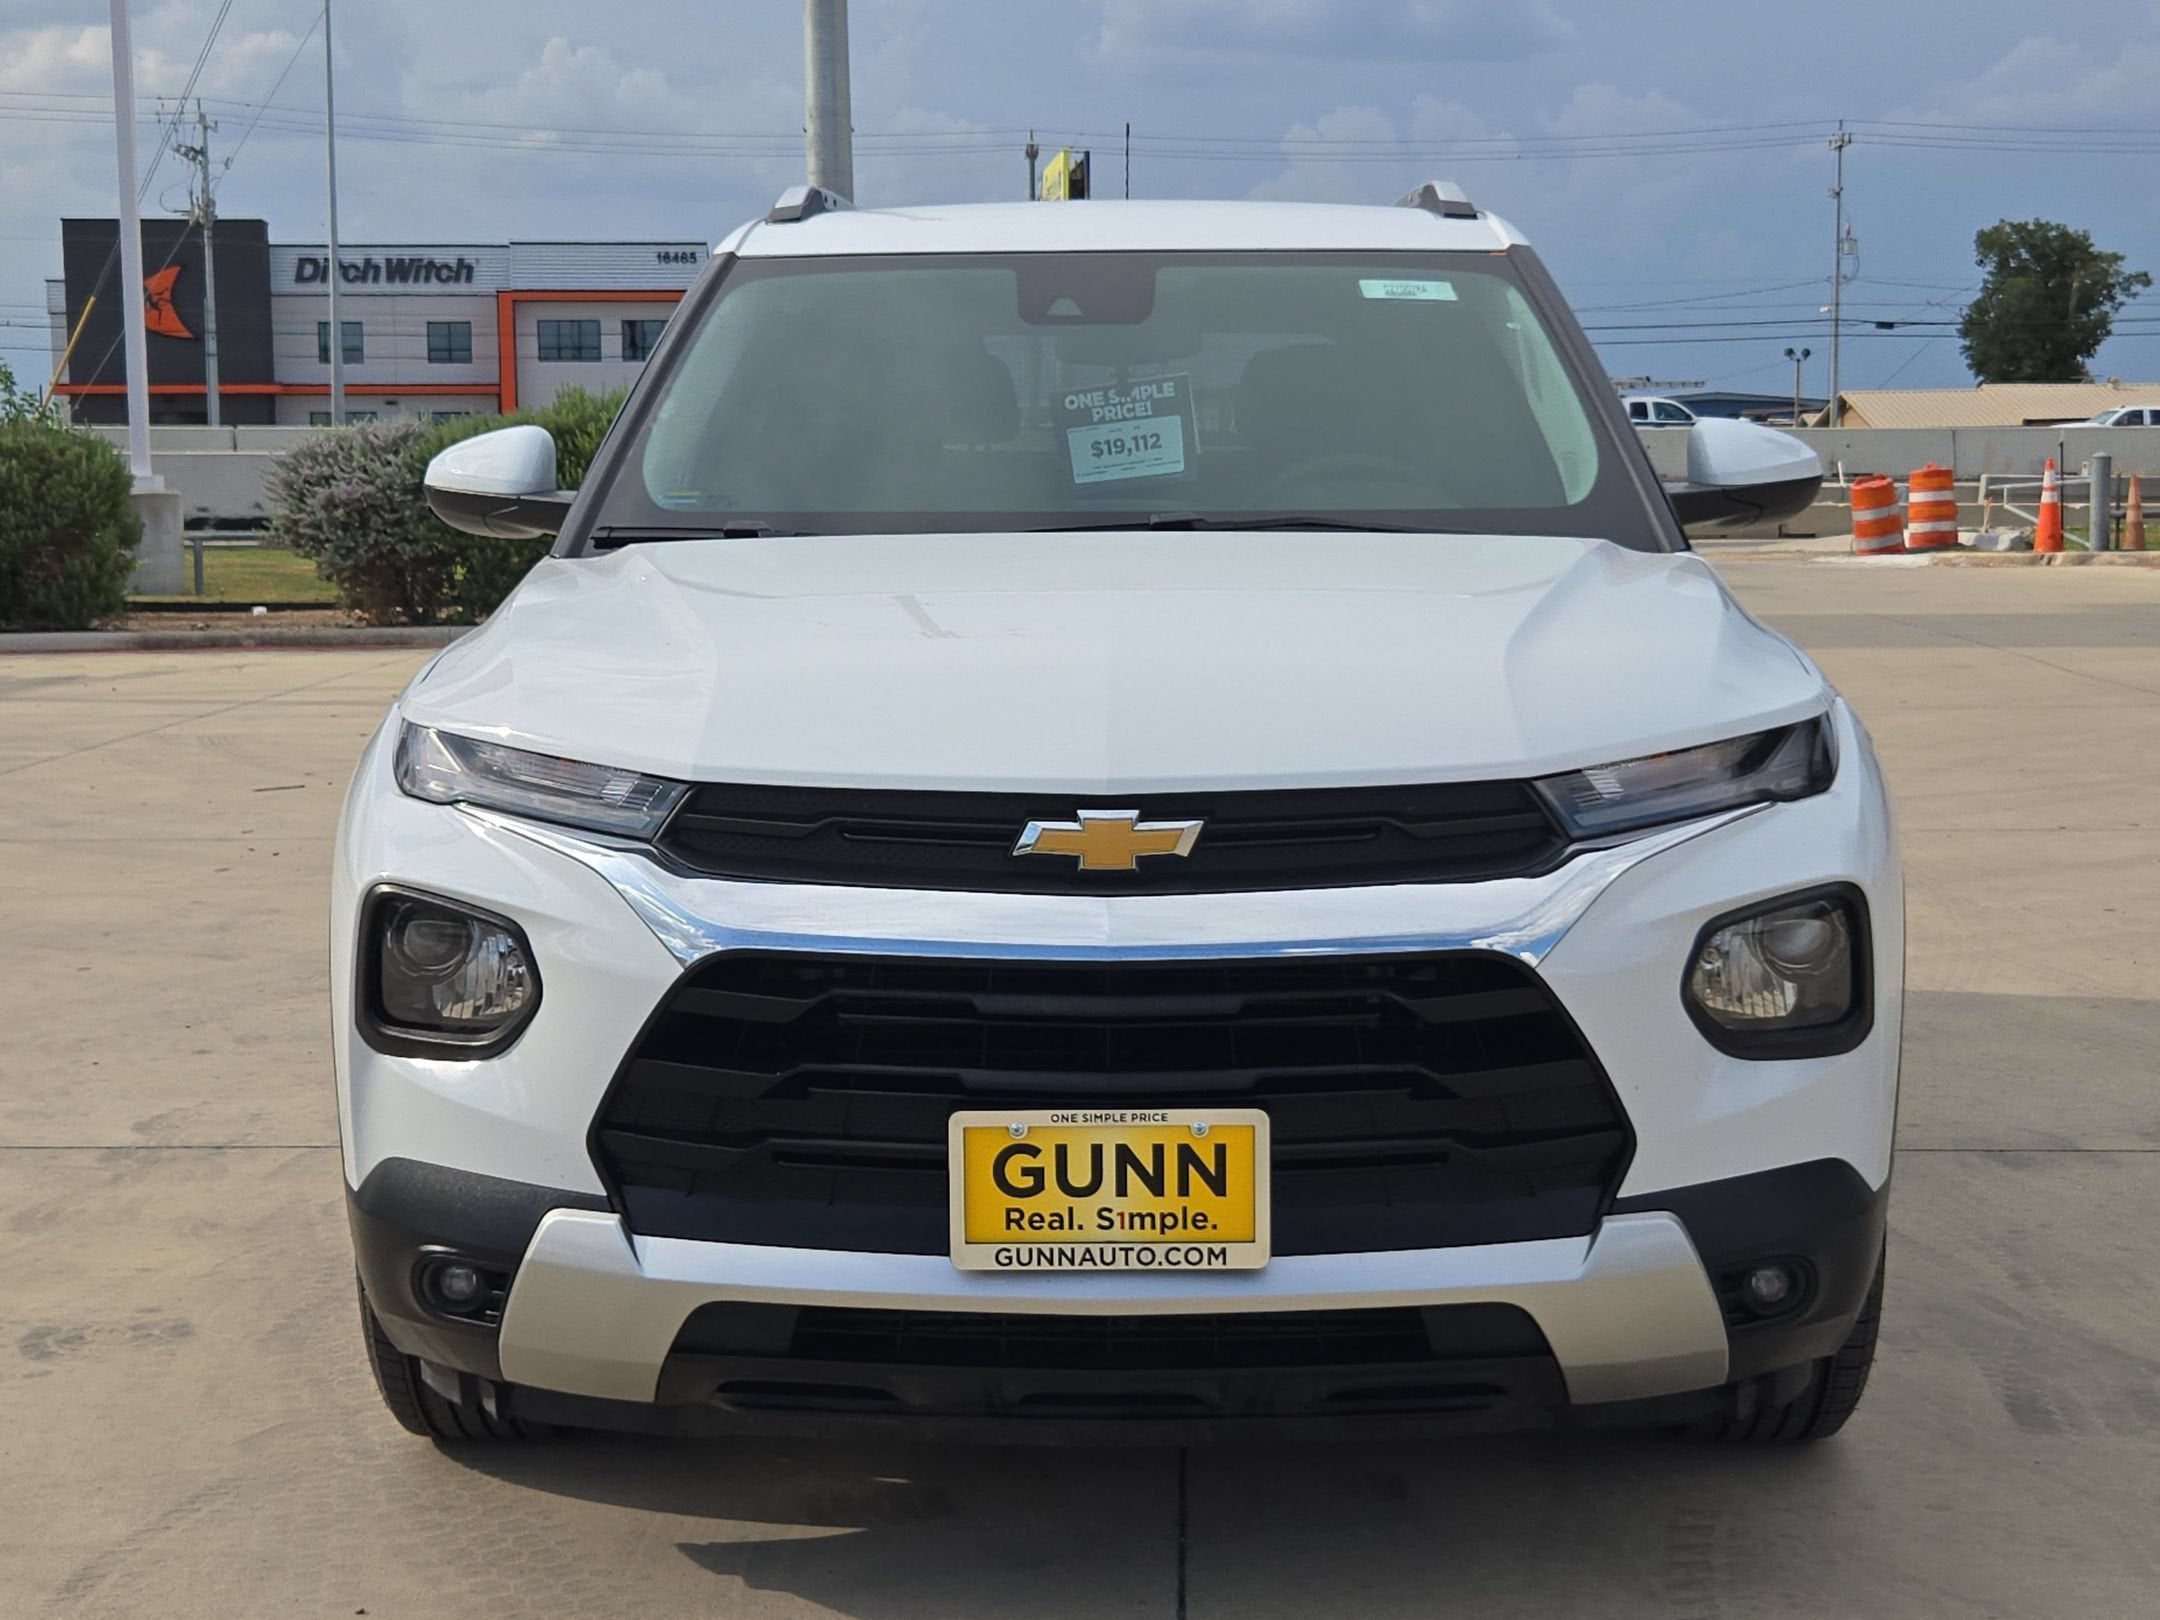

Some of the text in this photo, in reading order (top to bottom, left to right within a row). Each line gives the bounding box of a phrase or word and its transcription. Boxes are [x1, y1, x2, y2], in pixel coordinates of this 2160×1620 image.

[656, 251, 698, 265] 16465
[295, 256, 475, 284] Dich Witch
[1064, 391, 1106, 411] ONE
[1091, 401, 1153, 422] PRICE!
[1090, 432, 1162, 459] $19,112
[1050, 1112, 1169, 1123] ONE SIMPLE PRICE
[992, 1143, 1227, 1198] GUNN
[1005, 1207, 1084, 1231] Real.
[994, 1247, 1227, 1267] GUNNAUTO.COM
